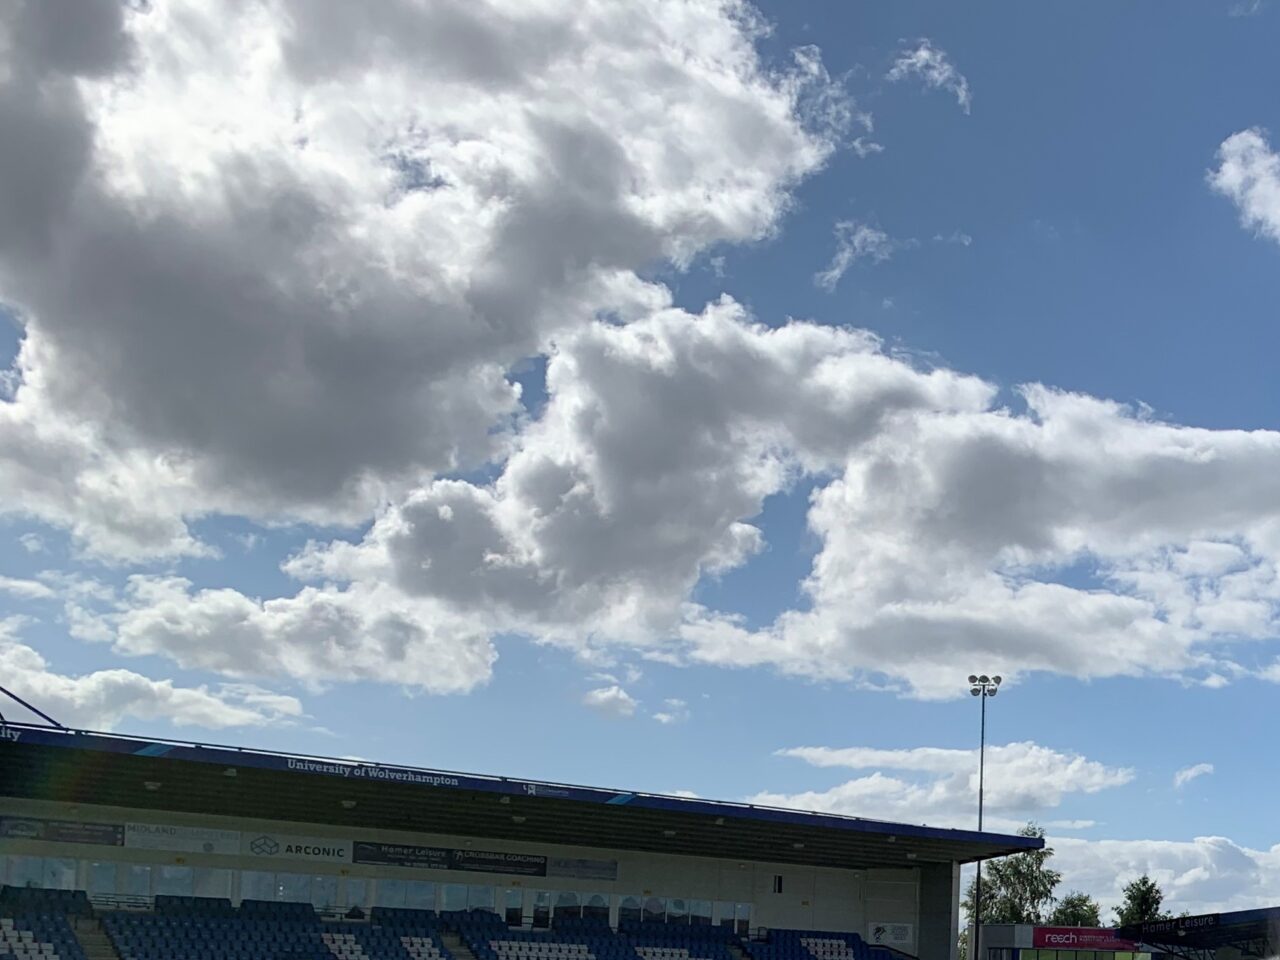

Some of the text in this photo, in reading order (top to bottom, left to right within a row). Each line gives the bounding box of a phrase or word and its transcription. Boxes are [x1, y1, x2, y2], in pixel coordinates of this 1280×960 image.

[287, 759, 459, 786] University of Wolverhampton
[127, 824, 177, 836] MIDLAND
[285, 844, 345, 858] ARCONIC
[381, 846, 446, 857] Hamer Leisure
[506, 856, 545, 864] COACHING
[1142, 915, 1215, 934] Hamer Leisure
[1045, 932, 1077, 944] reech
